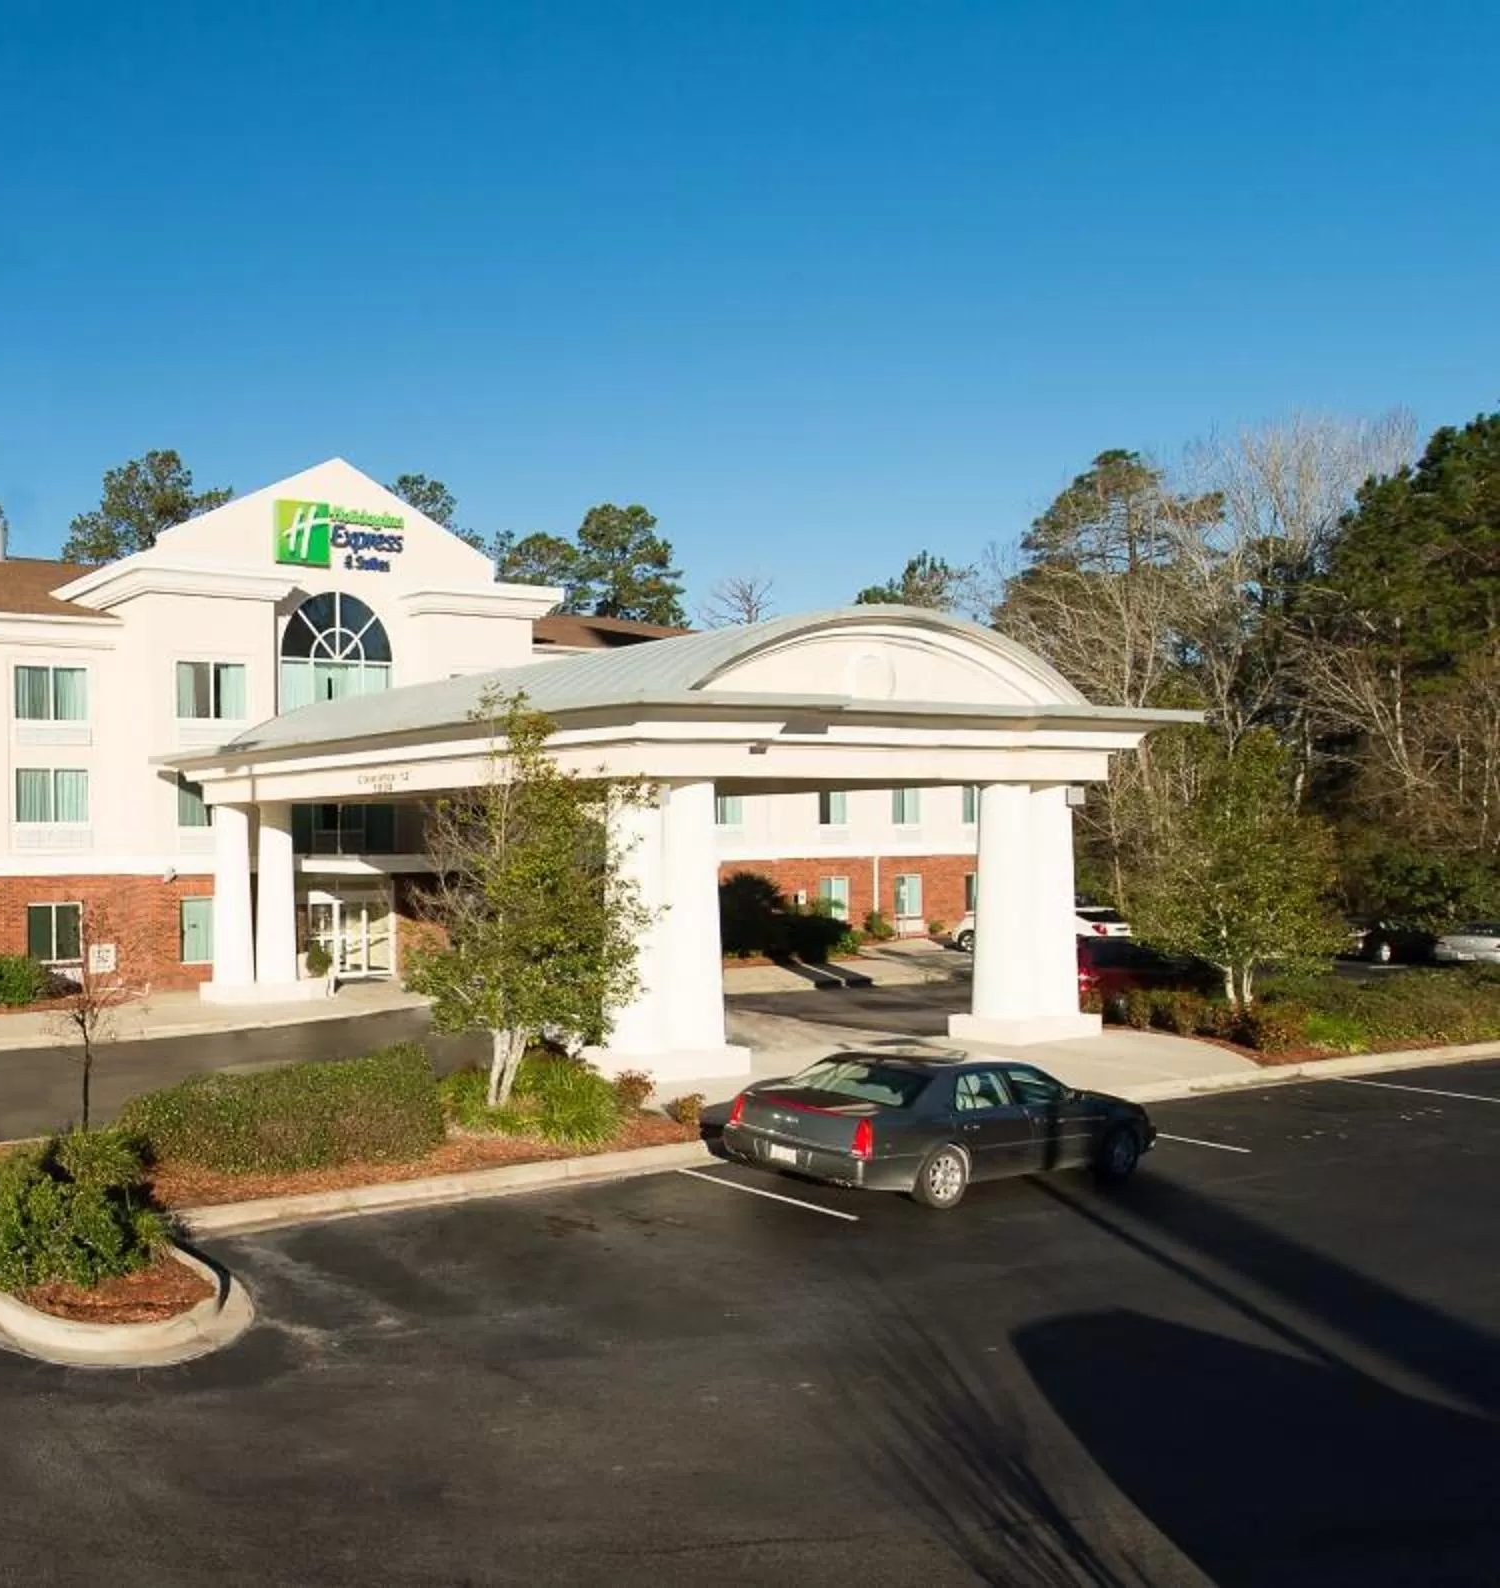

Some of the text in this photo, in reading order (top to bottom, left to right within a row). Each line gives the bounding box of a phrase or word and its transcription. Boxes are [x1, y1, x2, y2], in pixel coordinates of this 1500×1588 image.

[281, 504, 331, 560] H
[331, 524, 404, 554] Express
[355, 555, 390, 572] Suites
